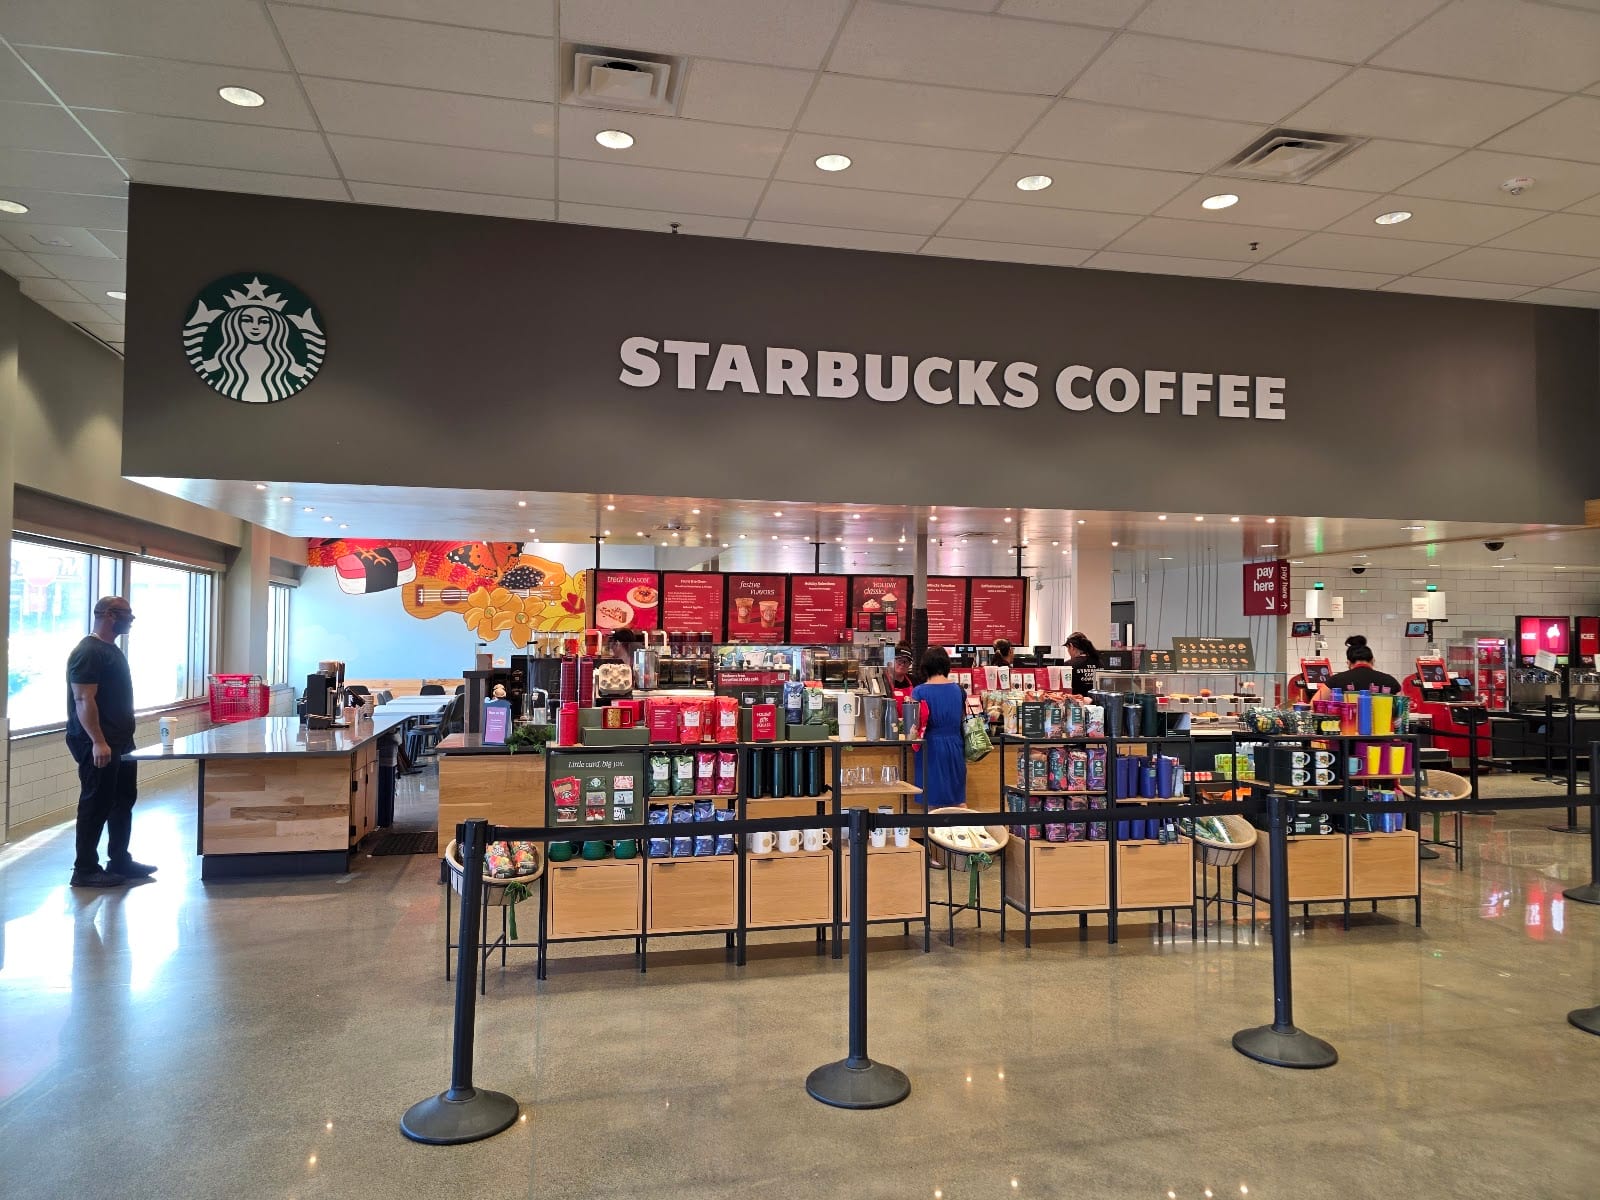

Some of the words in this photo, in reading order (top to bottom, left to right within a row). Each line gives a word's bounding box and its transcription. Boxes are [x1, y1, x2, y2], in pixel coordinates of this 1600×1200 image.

[619, 336, 1039, 409] STARBUCKS
[1055, 365, 1287, 421] COFFEE
[1256, 566, 1275, 579] pay
[740, 580, 761, 588] festive
[1253, 580, 1275, 592] here
[863, 588, 886, 596] classics
[568, 760, 585, 768] Little
[601, 760, 612, 768] big
